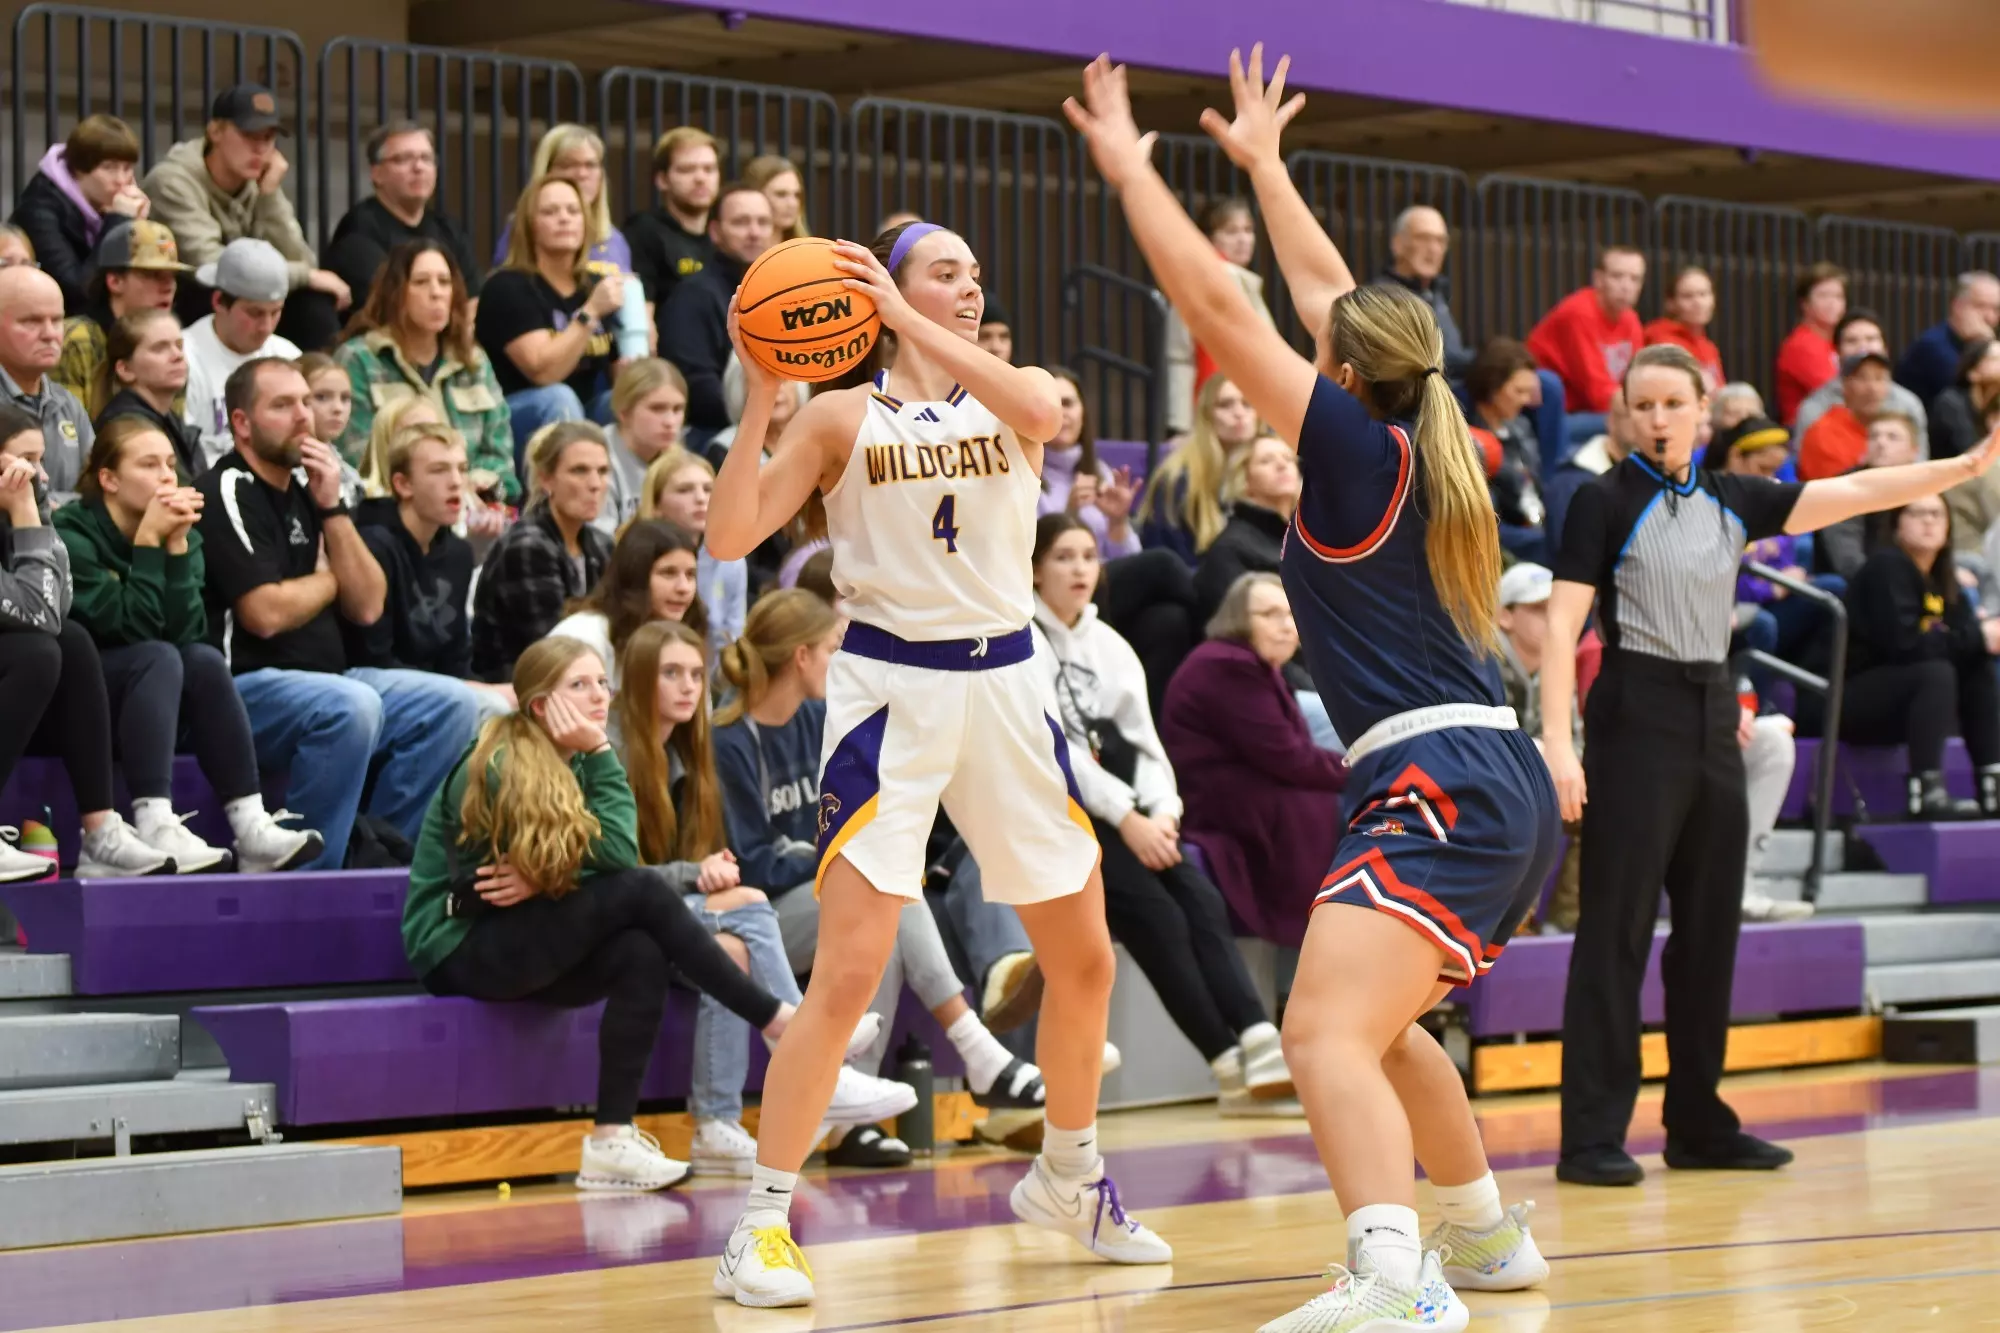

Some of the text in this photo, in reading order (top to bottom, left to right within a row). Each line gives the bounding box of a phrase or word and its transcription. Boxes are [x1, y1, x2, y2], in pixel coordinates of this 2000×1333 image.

[781, 296, 852, 331] NCAA
[775, 331, 869, 368] Wilson
[864, 432, 1010, 486] WILDCATS
[931, 493, 960, 554] 4
